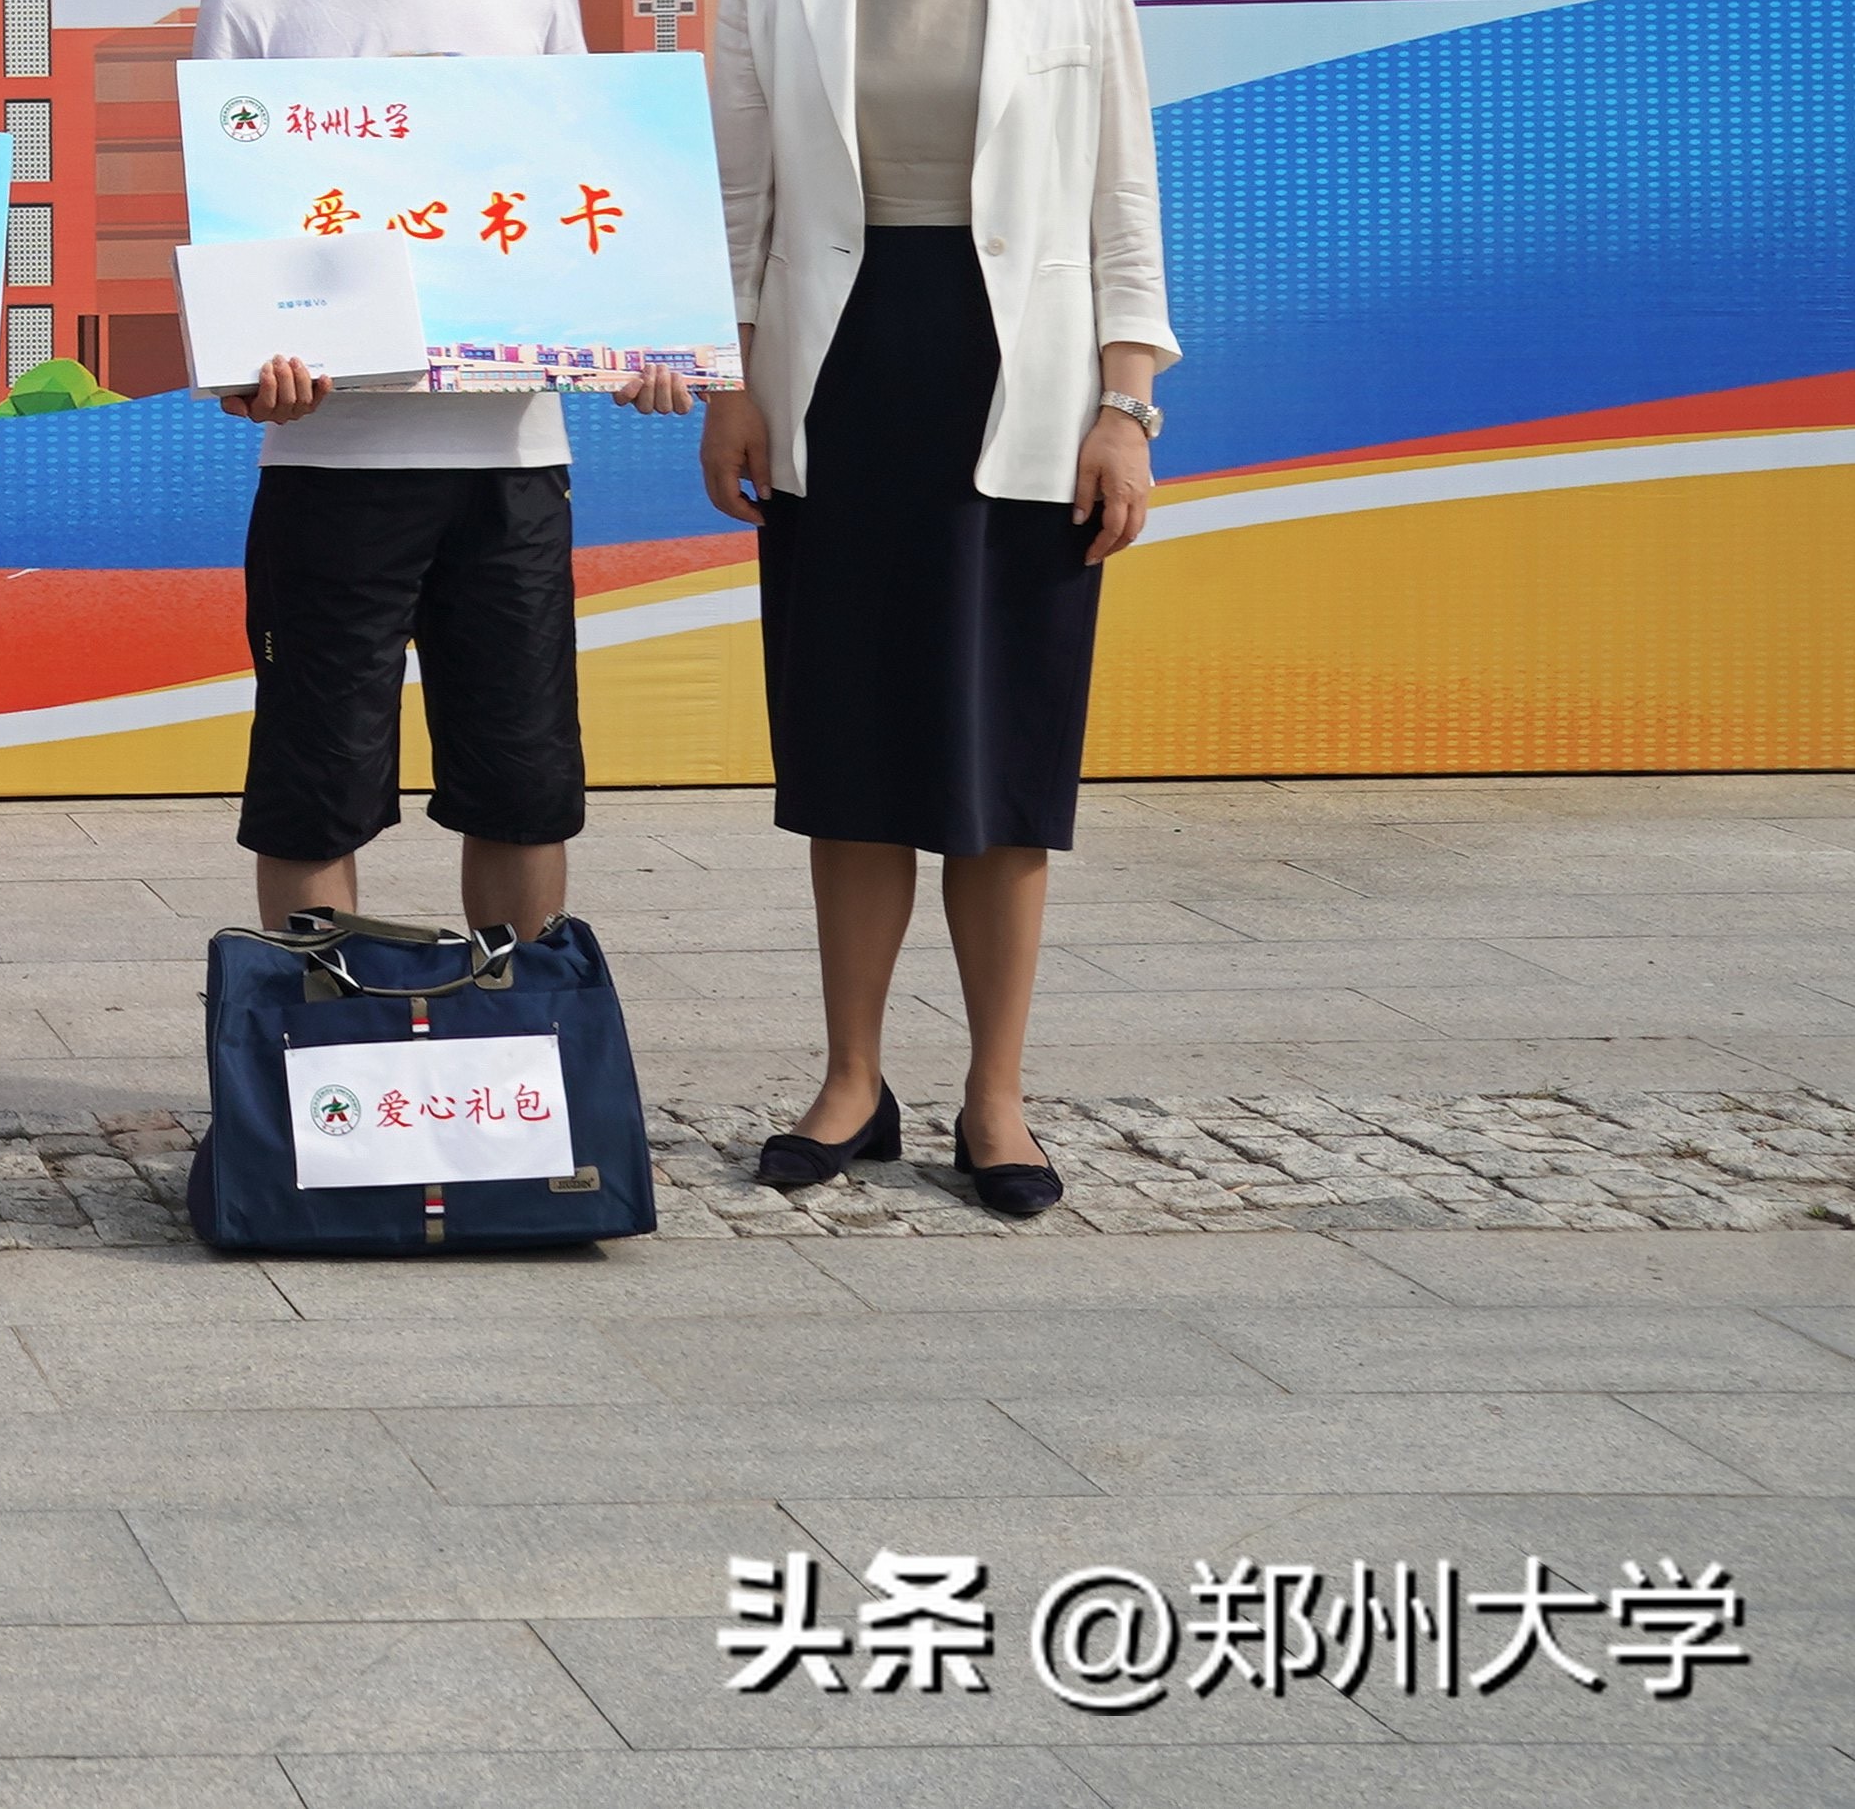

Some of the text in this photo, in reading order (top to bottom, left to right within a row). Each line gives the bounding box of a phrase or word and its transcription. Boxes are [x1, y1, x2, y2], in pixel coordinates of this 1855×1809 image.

[286, 103, 410, 141] 郑州大学
[302, 183, 626, 255] 爱心书卡
[376, 1082, 551, 1129] 爱心礼包
